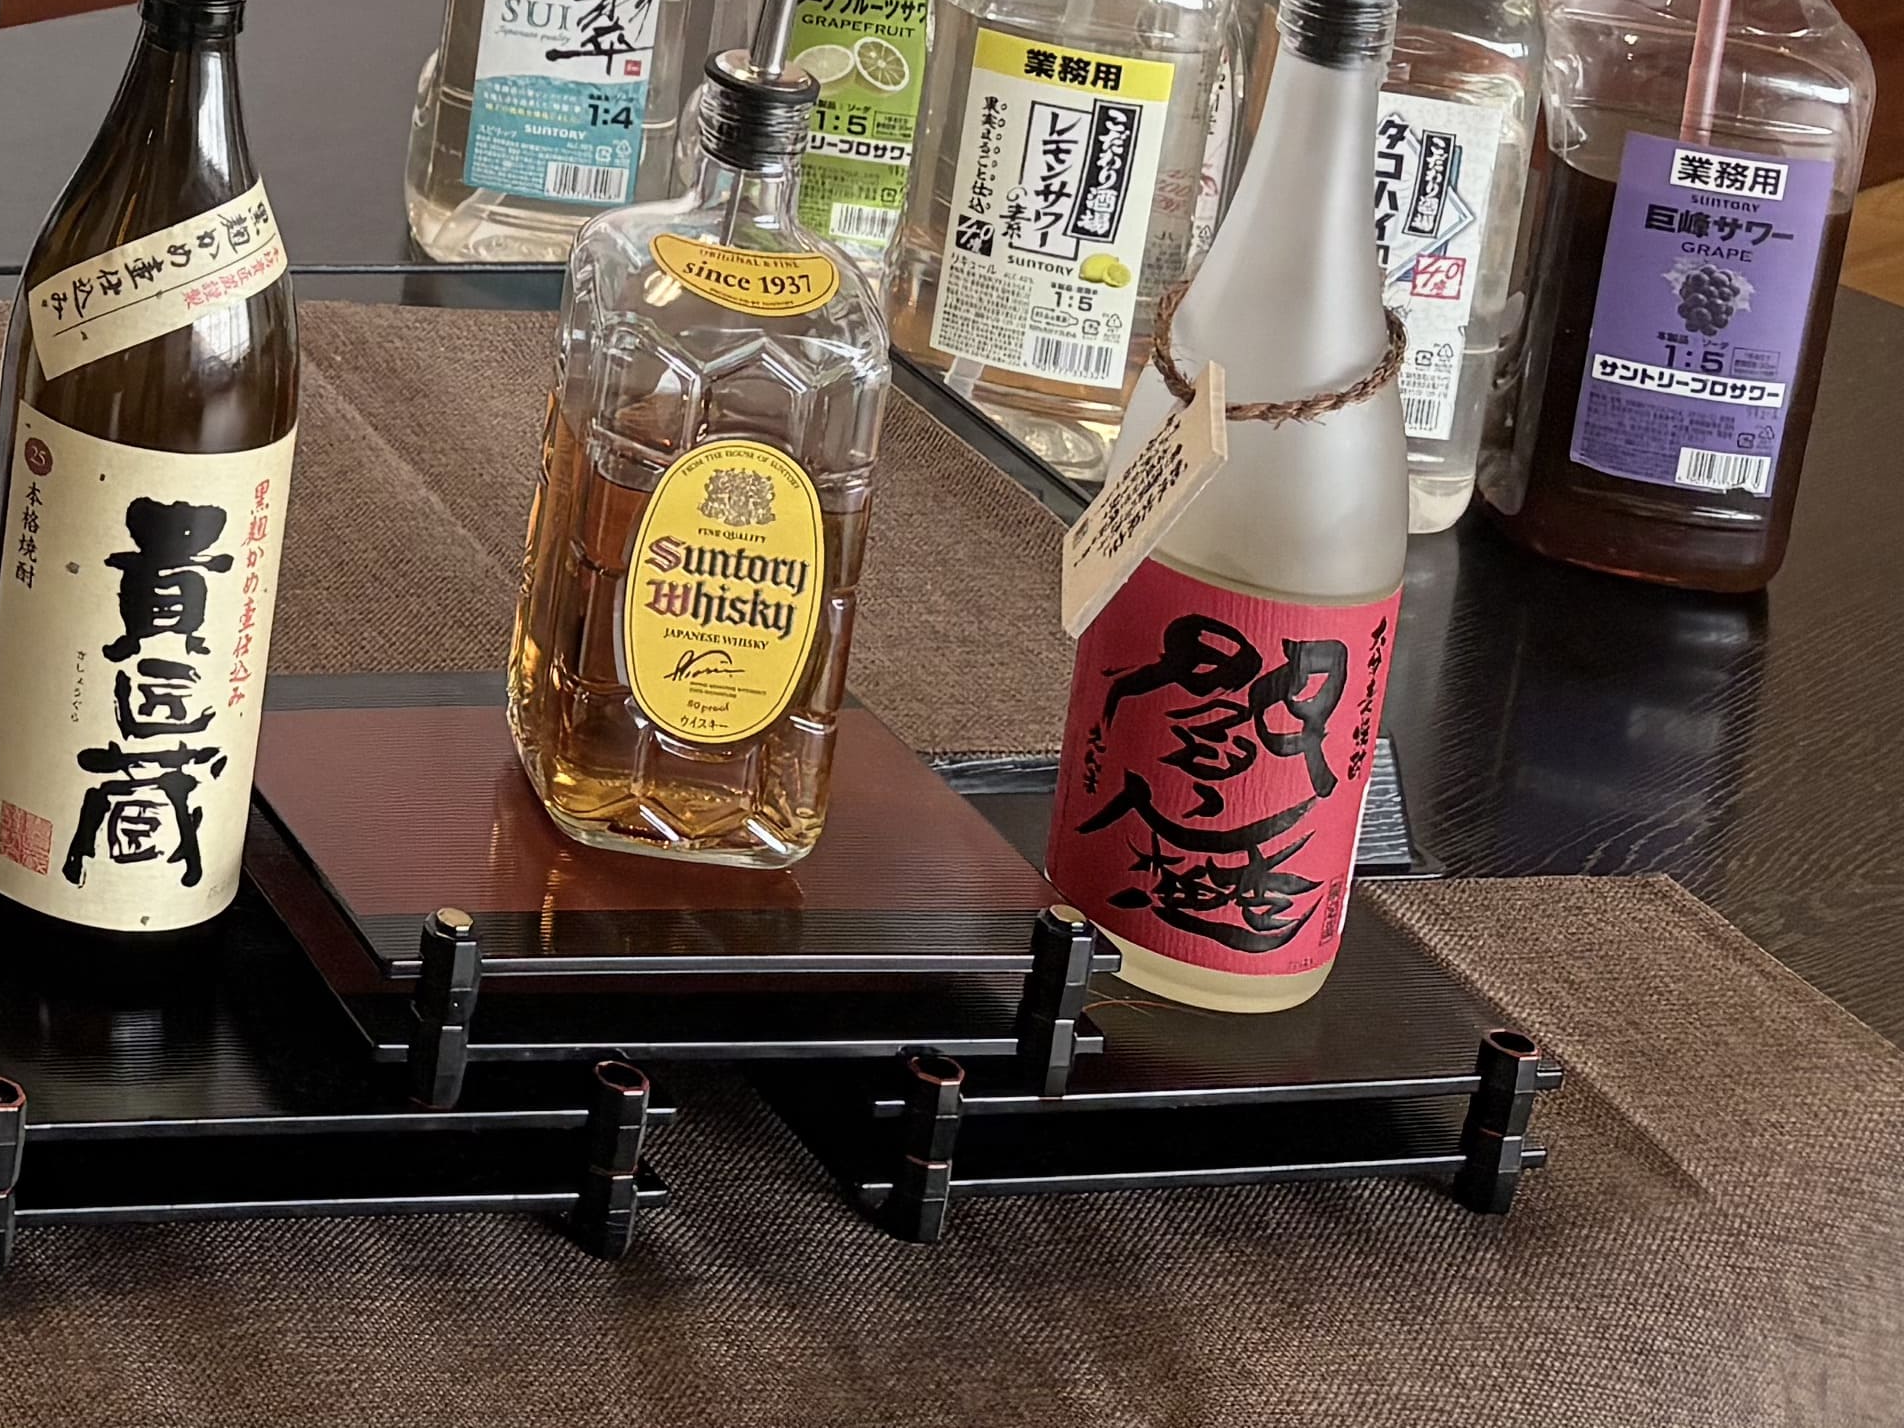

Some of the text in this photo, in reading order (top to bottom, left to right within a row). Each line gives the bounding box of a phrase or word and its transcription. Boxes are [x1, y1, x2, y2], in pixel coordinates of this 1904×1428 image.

[802, 14, 916, 38] GRAPEFRUIT
[1024, 48, 1122, 91] 業務用
[587, 104, 634, 129] 1:4
[816, 110, 867, 136] 1:5
[524, 124, 587, 140] SUNTORY
[1033, 111, 1083, 248] レモンサワー
[1077, 108, 1132, 236] こだわり酒場
[1678, 154, 1782, 196] 業務用
[1691, 194, 1761, 213] SUNTORY
[1645, 204, 1795, 245] 巨峰サワー
[1007, 255, 1074, 277] SUNTORY
[1681, 241, 1753, 263] GRAPE
[682, 260, 812, 295] since 1937
[1055, 291, 1093, 312] 1:5
[1665, 344, 1724, 373] 1:5
[1599, 359, 1780, 401] サントリープロサワー
[29, 443, 47, 466] 25
[15, 481, 43, 590] 本格焼酎
[645, 535, 808, 598] Suntory
[645, 580, 798, 641] Whisky
[664, 627, 770, 650] JAPANESE WHISKY
